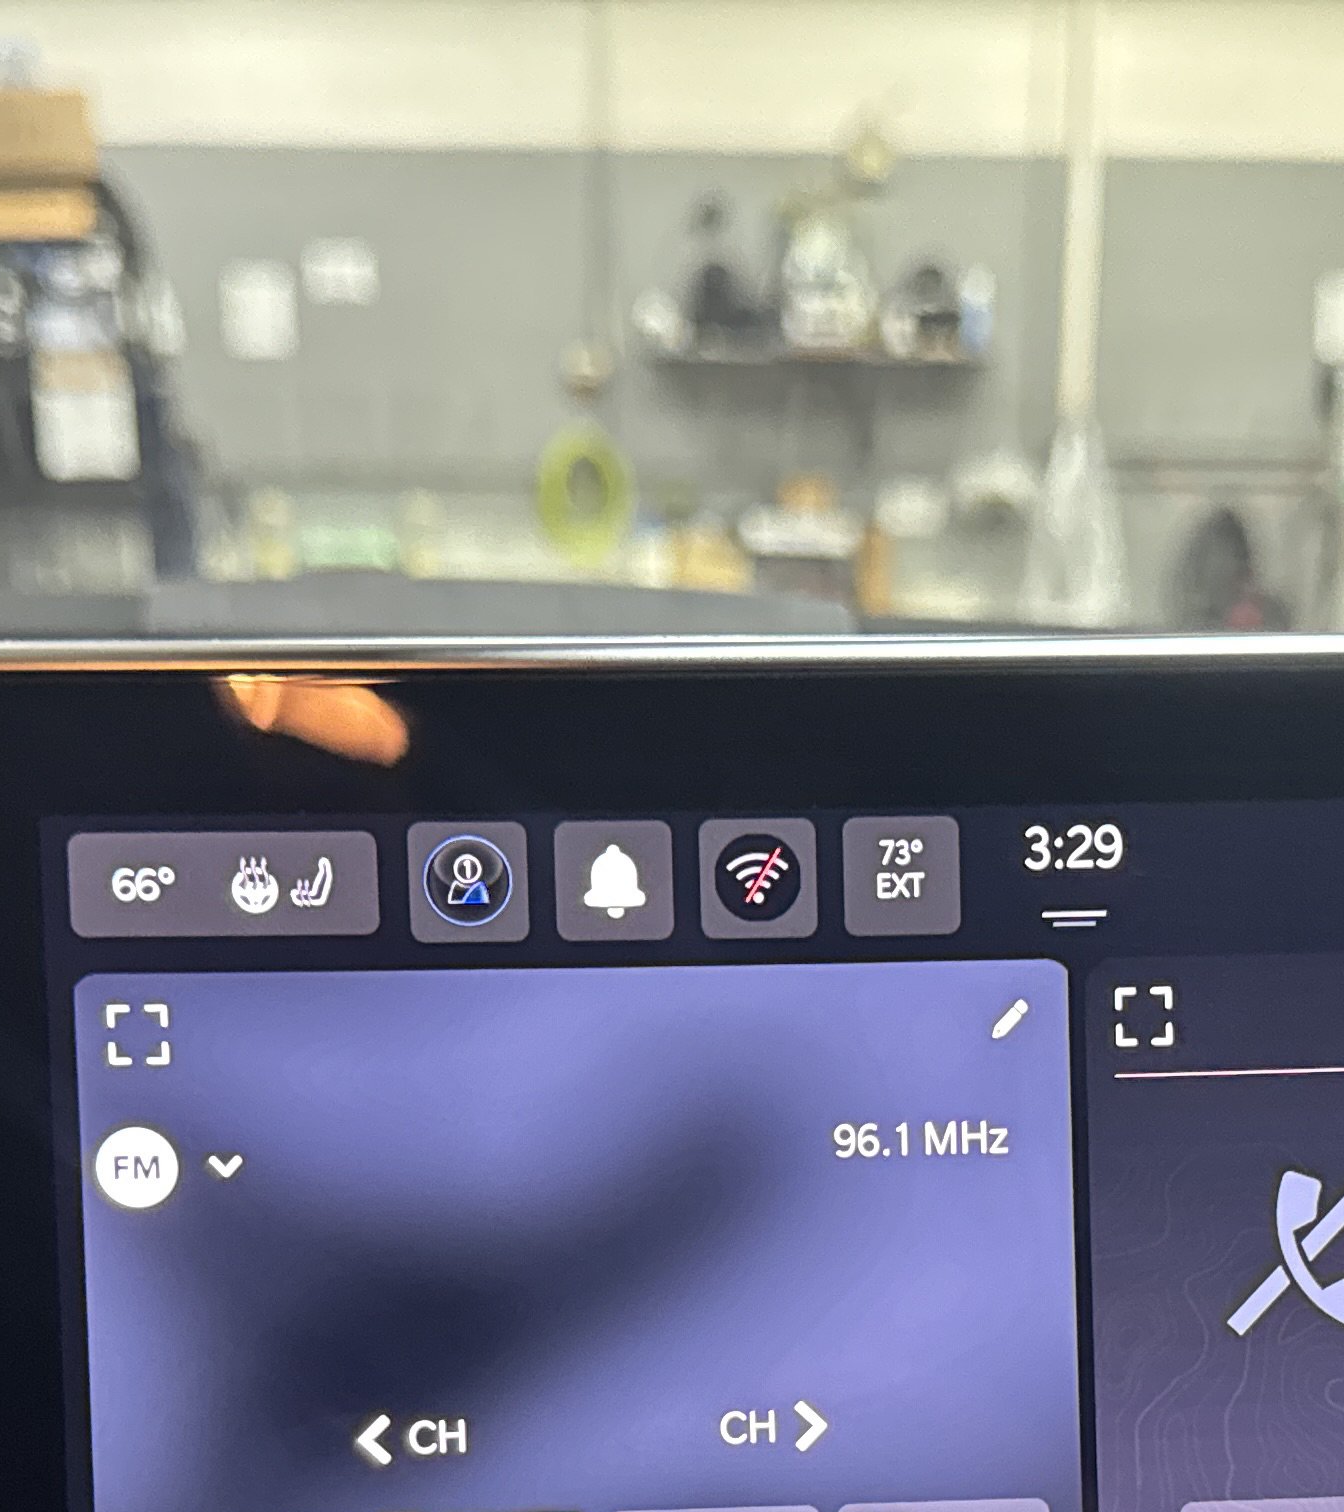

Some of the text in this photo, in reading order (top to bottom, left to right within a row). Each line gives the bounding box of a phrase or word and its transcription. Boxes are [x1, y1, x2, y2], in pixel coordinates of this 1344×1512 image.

[1023, 822, 1124, 872] 3:29
[875, 870, 927, 900] EXT
[832, 1119, 1010, 1159] 96.1 MHz
[113, 1154, 161, 1180] FM
[407, 1417, 468, 1456] CH
[718, 1408, 777, 1446] CH
